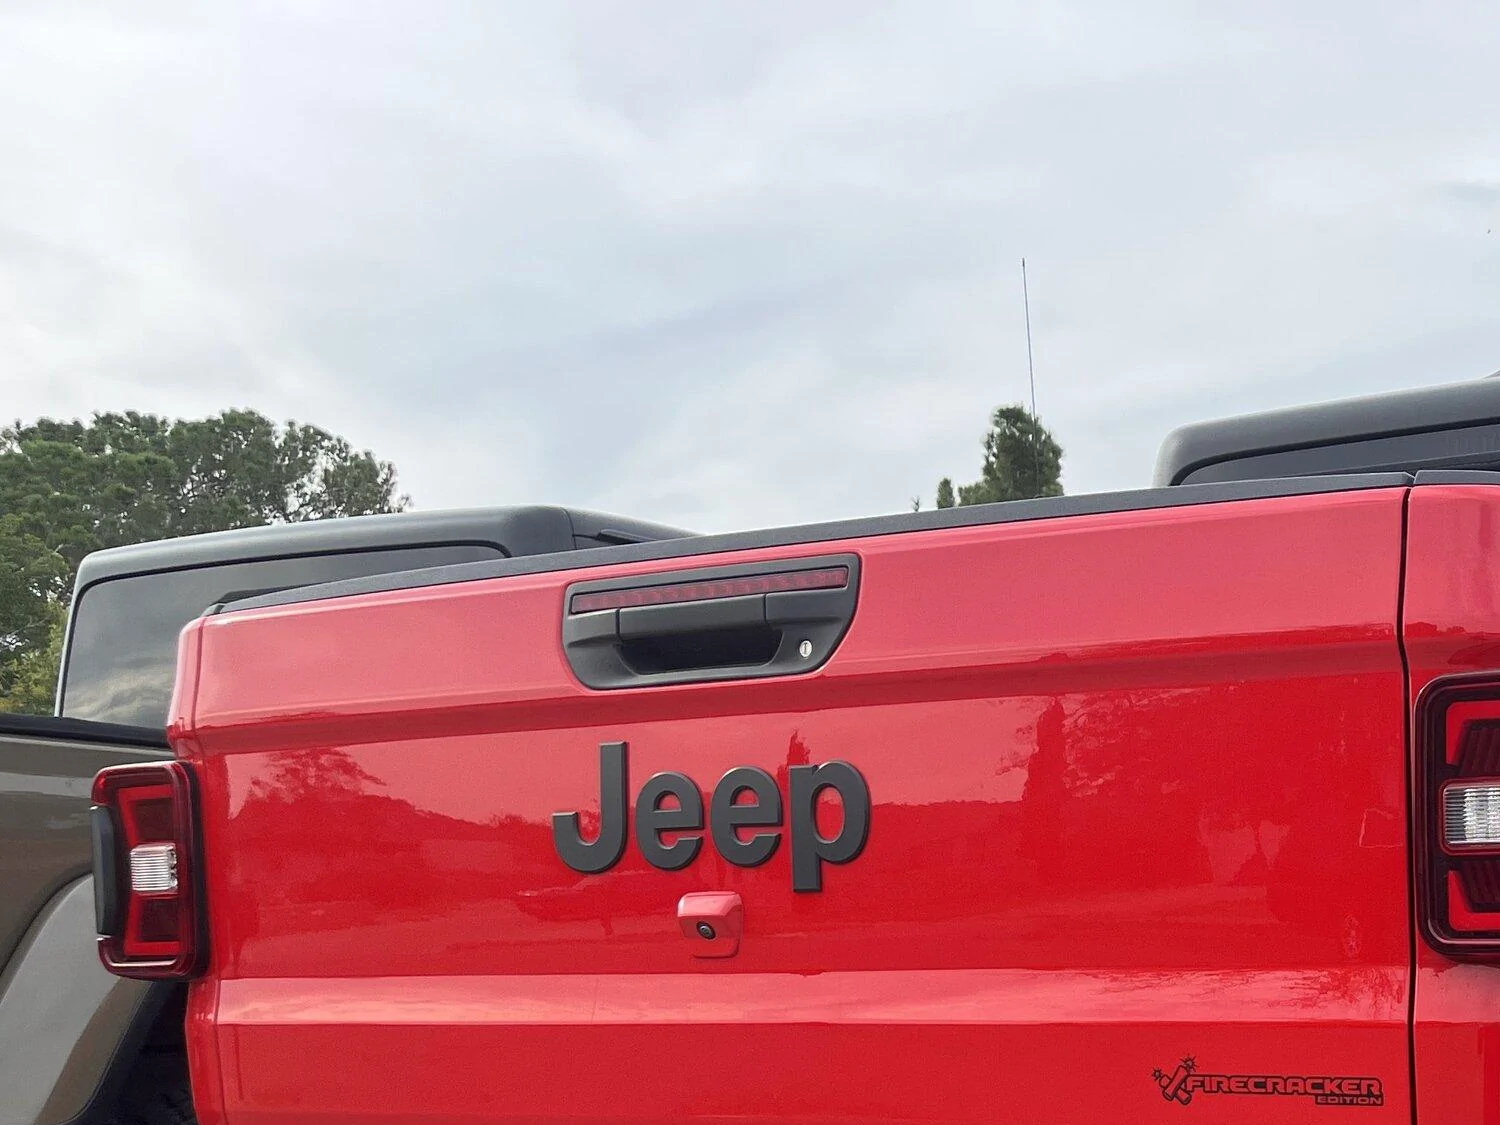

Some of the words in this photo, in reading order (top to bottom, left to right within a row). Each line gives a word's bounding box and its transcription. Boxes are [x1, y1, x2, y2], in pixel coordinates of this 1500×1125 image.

[552, 740, 872, 893] Jeep
[1186, 1074, 1383, 1096] FIRECRACKER
[1316, 1095, 1383, 1105] EDITION
